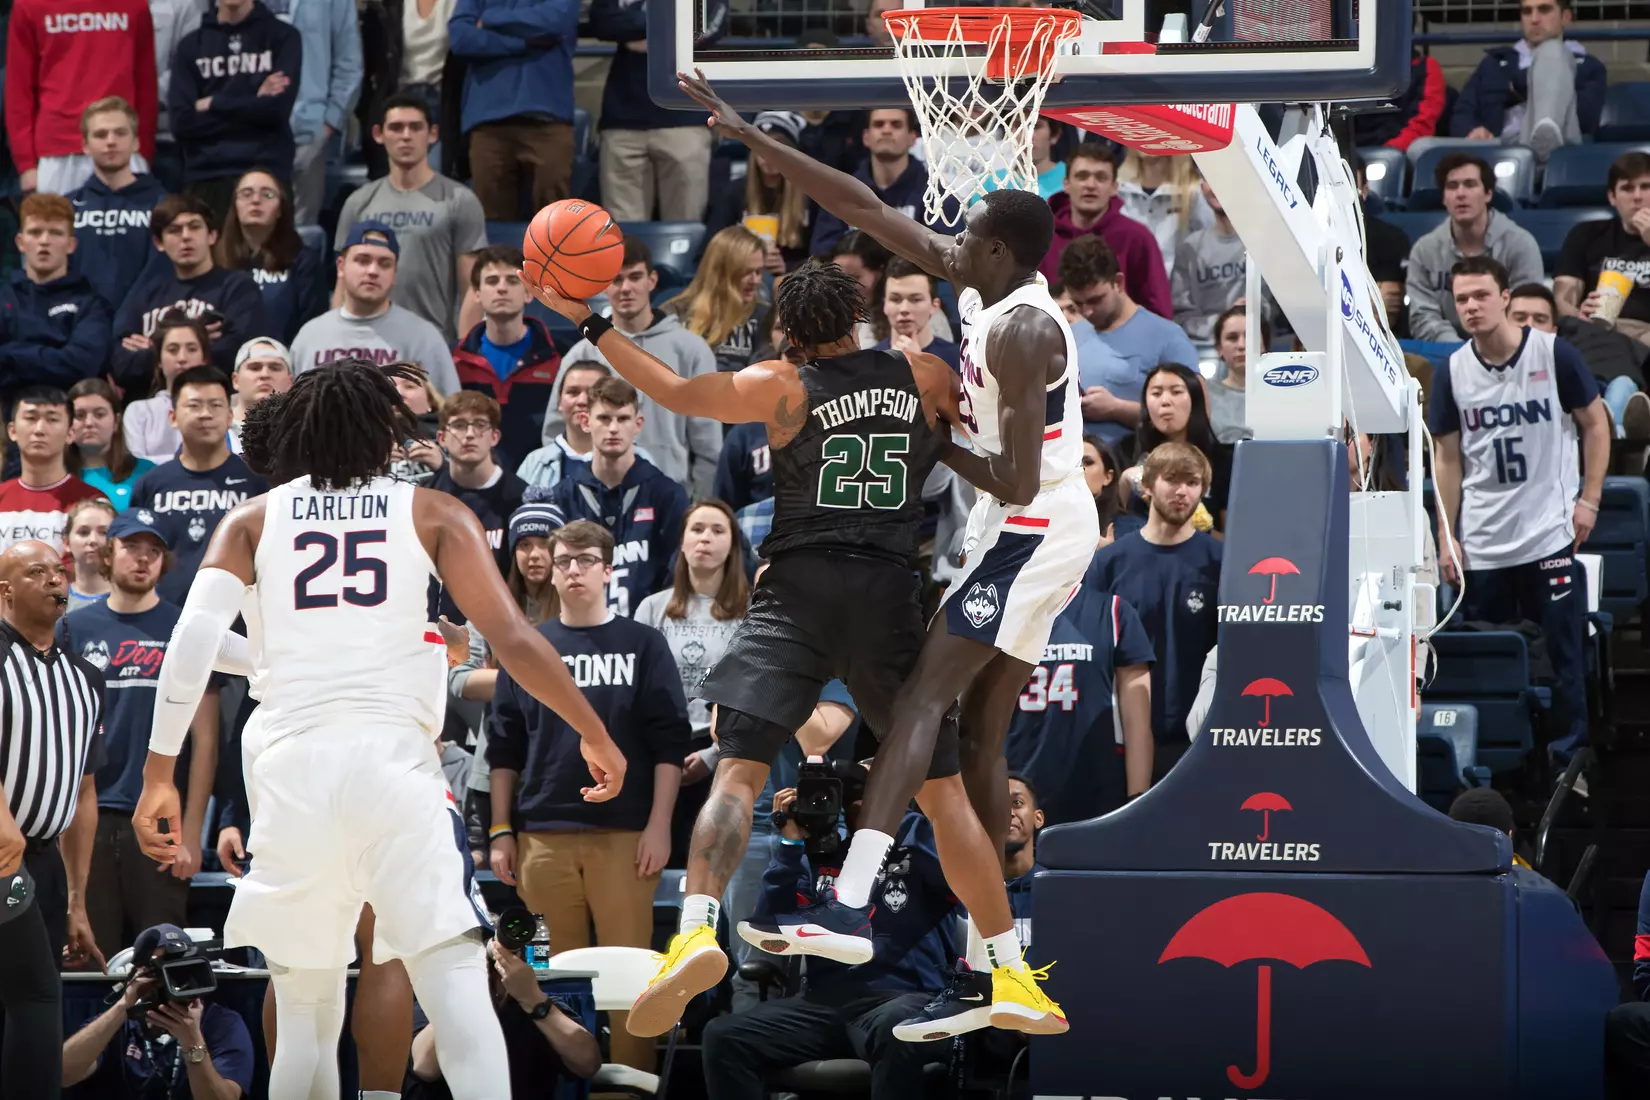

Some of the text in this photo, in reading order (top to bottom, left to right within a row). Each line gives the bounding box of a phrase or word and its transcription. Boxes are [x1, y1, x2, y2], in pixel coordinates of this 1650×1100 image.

[45, 12, 128, 33] UCONN
[1256, 137, 1298, 209] LEGACY
[1354, 309, 1396, 385] SPORTS
[811, 388, 918, 430] THOMPSON
[1463, 398, 1552, 432] UCONN
[816, 433, 910, 510] 25
[1493, 437, 1527, 484] 15
[154, 490, 247, 513] UCONN
[292, 495, 388, 520] CARLTON
[517, 522, 549, 533] UCONN
[294, 529, 388, 610] 25
[1217, 605, 1325, 623] TRAVELERS
[1019, 663, 1079, 712] 34
[1438, 712, 1451, 725] 16
[1210, 728, 1322, 746] TRAVELERS
[1208, 842, 1321, 862] TRAVELERS
